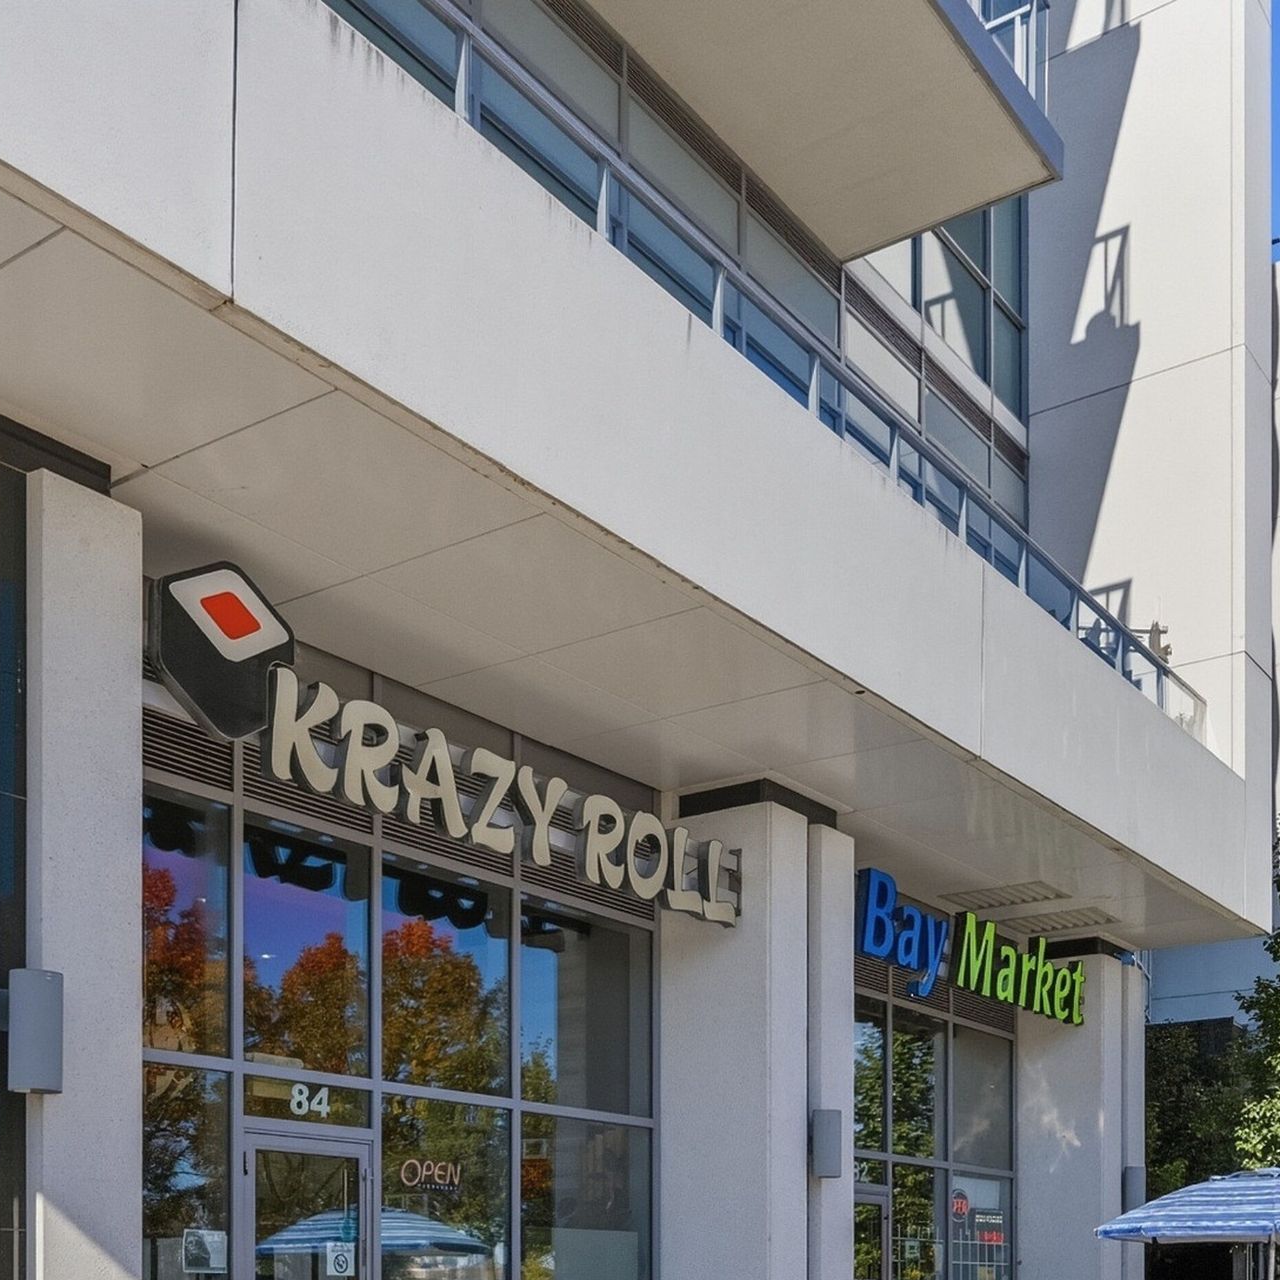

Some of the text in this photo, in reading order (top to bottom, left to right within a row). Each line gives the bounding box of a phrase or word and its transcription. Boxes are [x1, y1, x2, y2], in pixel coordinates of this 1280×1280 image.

[269, 666, 737, 929] KRAZY ROLL
[862, 867, 1086, 1026] Bay Market
[290, 1083, 331, 1119] 84
[400, 1159, 462, 1187] OPEN
